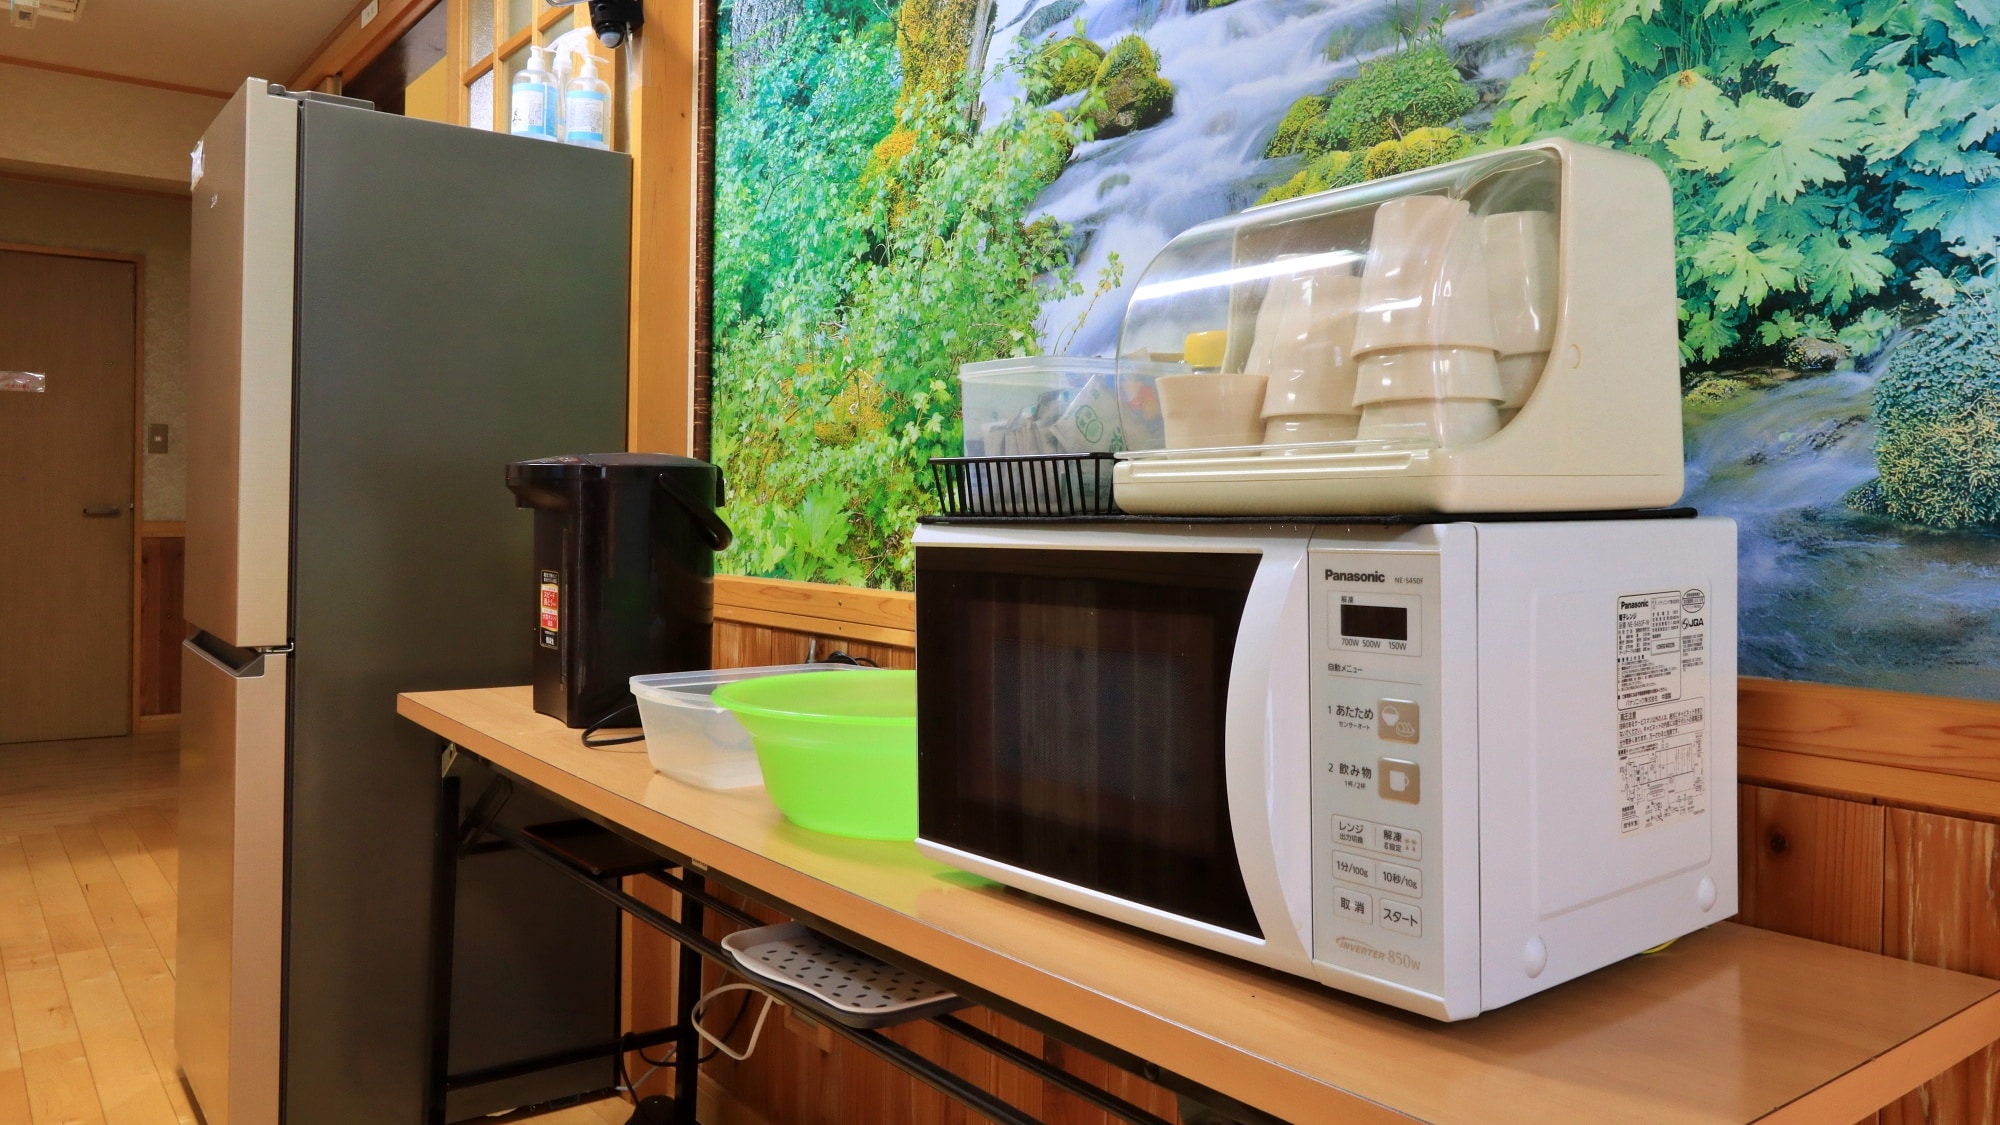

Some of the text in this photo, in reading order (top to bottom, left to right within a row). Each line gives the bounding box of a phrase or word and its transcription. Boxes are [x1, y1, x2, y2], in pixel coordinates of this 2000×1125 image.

[1325, 569, 1424, 585] Panasonic NE-S450F
[1620, 599, 1649, 610] Panasonic
[1341, 638, 1407, 650] 700W 500W 150W
[1328, 663, 1363, 673] 自動メニュー
[1336, 705, 1374, 720] あたため
[1338, 721, 1371, 730] センサーオート
[1328, 763, 1372, 779] 2 飲み物
[1339, 821, 1364, 834] レンジ
[1383, 829, 1402, 843] 解凍
[1336, 860, 1369, 878] 1分/100g
[1383, 871, 1418, 889] 10秒/10g
[1383, 908, 1418, 927] スタート
[1339, 939, 1386, 961] INVERTER
